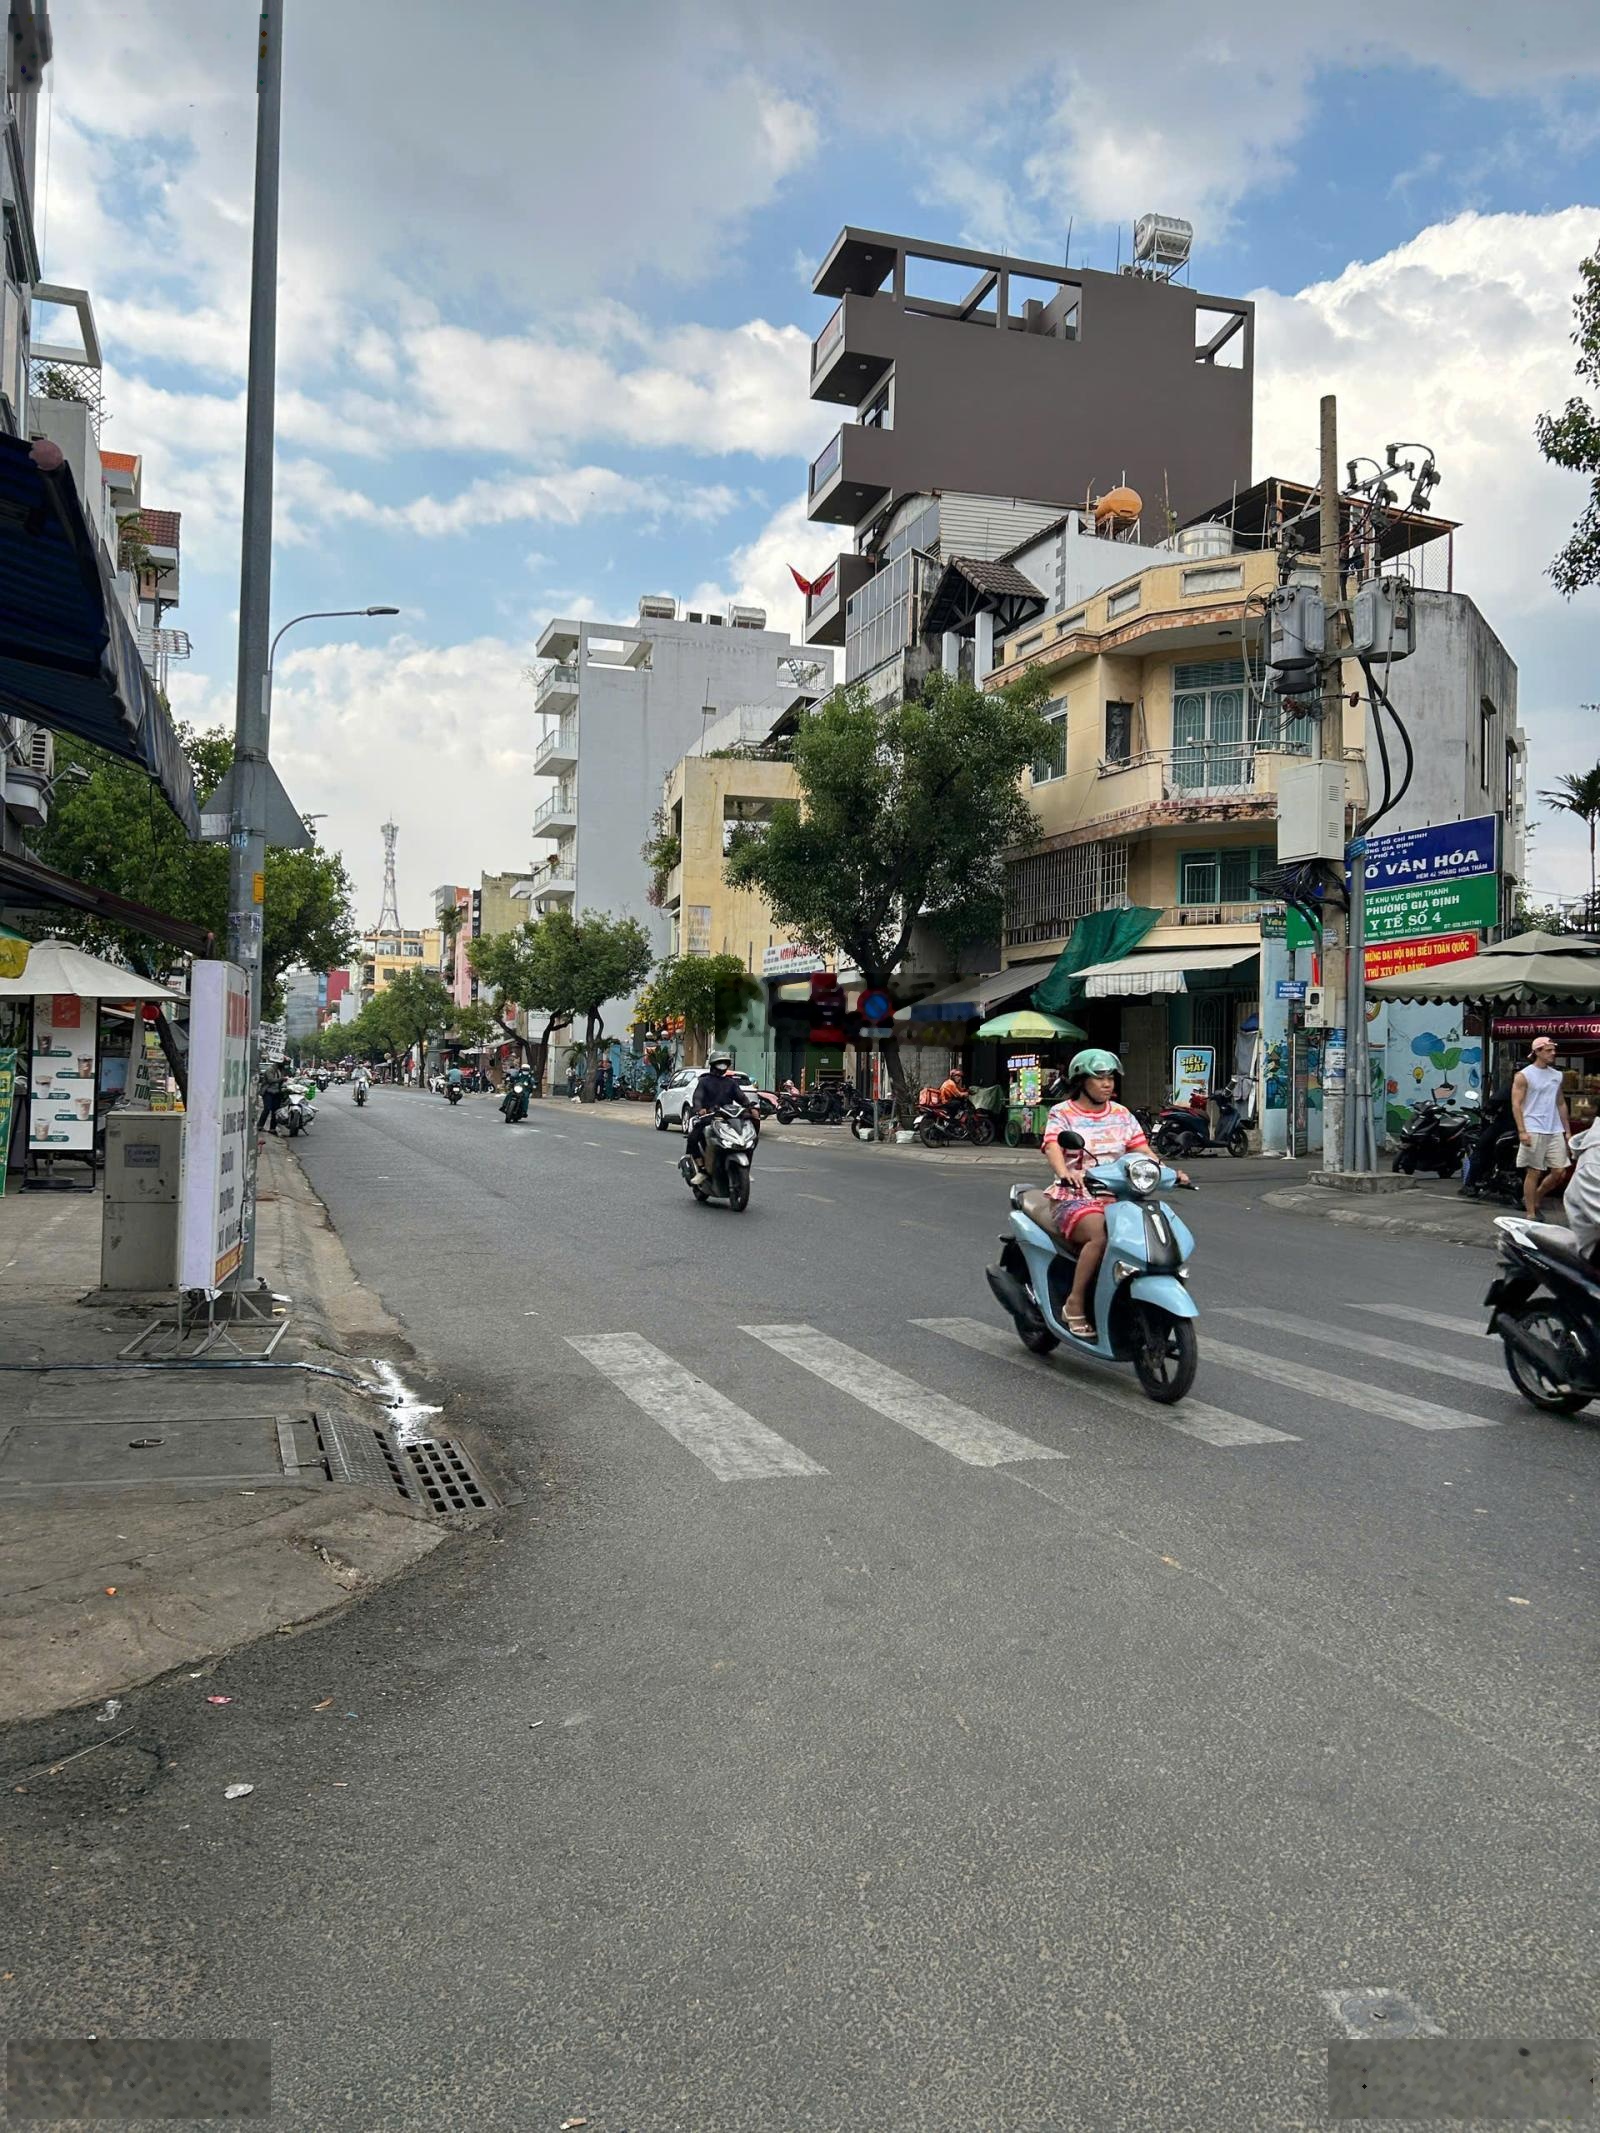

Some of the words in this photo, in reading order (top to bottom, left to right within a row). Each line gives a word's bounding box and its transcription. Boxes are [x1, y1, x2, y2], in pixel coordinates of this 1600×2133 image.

[1386, 858, 1427, 876] VĂN
[1434, 849, 1480, 868] HÓA
[1366, 896, 1374, 906] TẾ
[1376, 896, 1390, 904] KHU
[1390, 892, 1404, 902] VỰC
[1406, 890, 1422, 900] BÌNH
[1425, 887, 1449, 899] THẠNH
[1366, 900, 1408, 916] PHƯỜNG
[1411, 900, 1429, 910] GIA
[1432, 894, 1460, 908] ĐỊNH
[1370, 920, 1380, 931] Y
[1384, 912, 1403, 929] TẾ
[1408, 908, 1428, 926] SỐ
[1432, 912, 1442, 923] 4
[1382, 950, 1392, 962] ĐẠI
[1394, 947, 1404, 960] HỘI
[1406, 948, 1416, 960] ĐẠI
[1418, 942, 1432, 956] BIỂU
[1434, 941, 1450, 956] TOÀN
[1452, 938, 1470, 953] QUỐC
[1367, 964, 1380, 978] THỨ
[1380, 966, 1392, 977] XIV
[1498, 1024, 1516, 1034] TIỆM
[1519, 1024, 1535, 1034] TRÀ
[1536, 1022, 1556, 1034] TRÁI
[1558, 1022, 1574, 1034] CÂY
